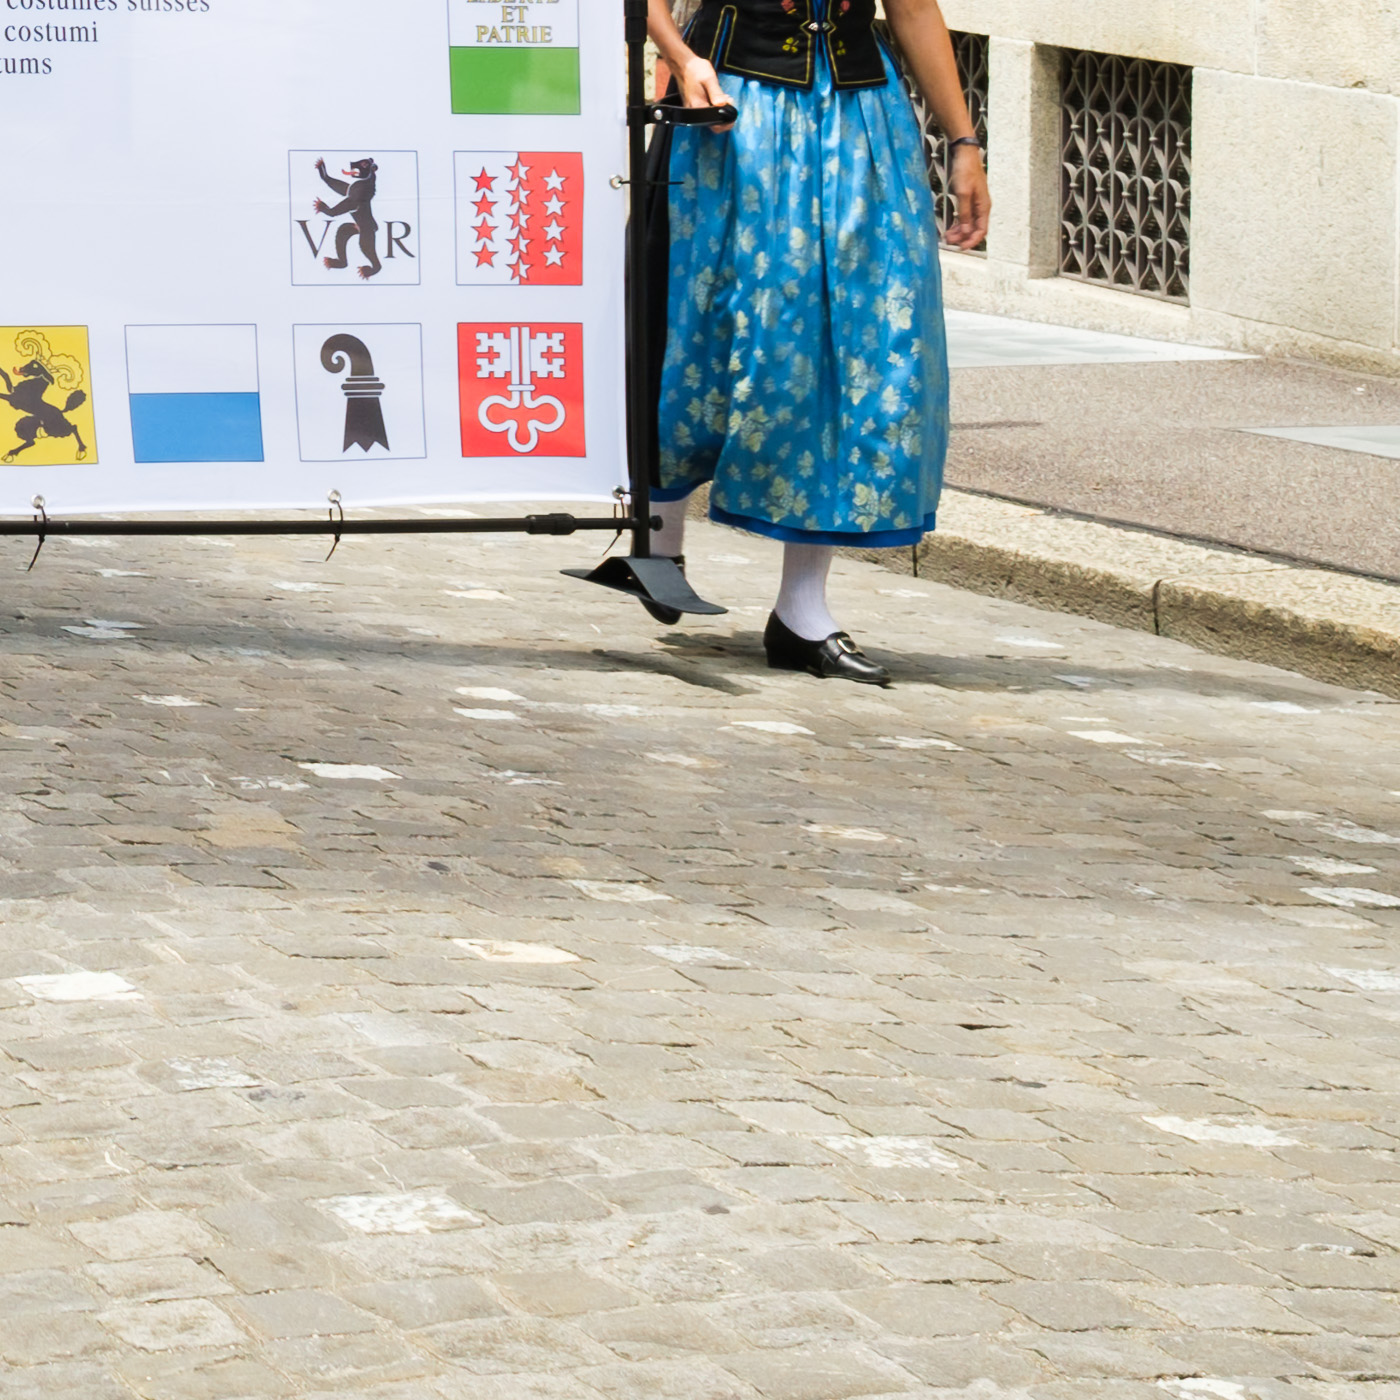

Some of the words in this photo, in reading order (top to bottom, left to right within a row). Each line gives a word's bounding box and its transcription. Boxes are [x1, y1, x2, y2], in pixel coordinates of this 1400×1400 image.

[501, 5, 529, 23] ET
[4, 21, 99, 42] costumi
[475, 25, 553, 43] PATRIE
[293, 219, 336, 259] V
[383, 220, 416, 259] R
